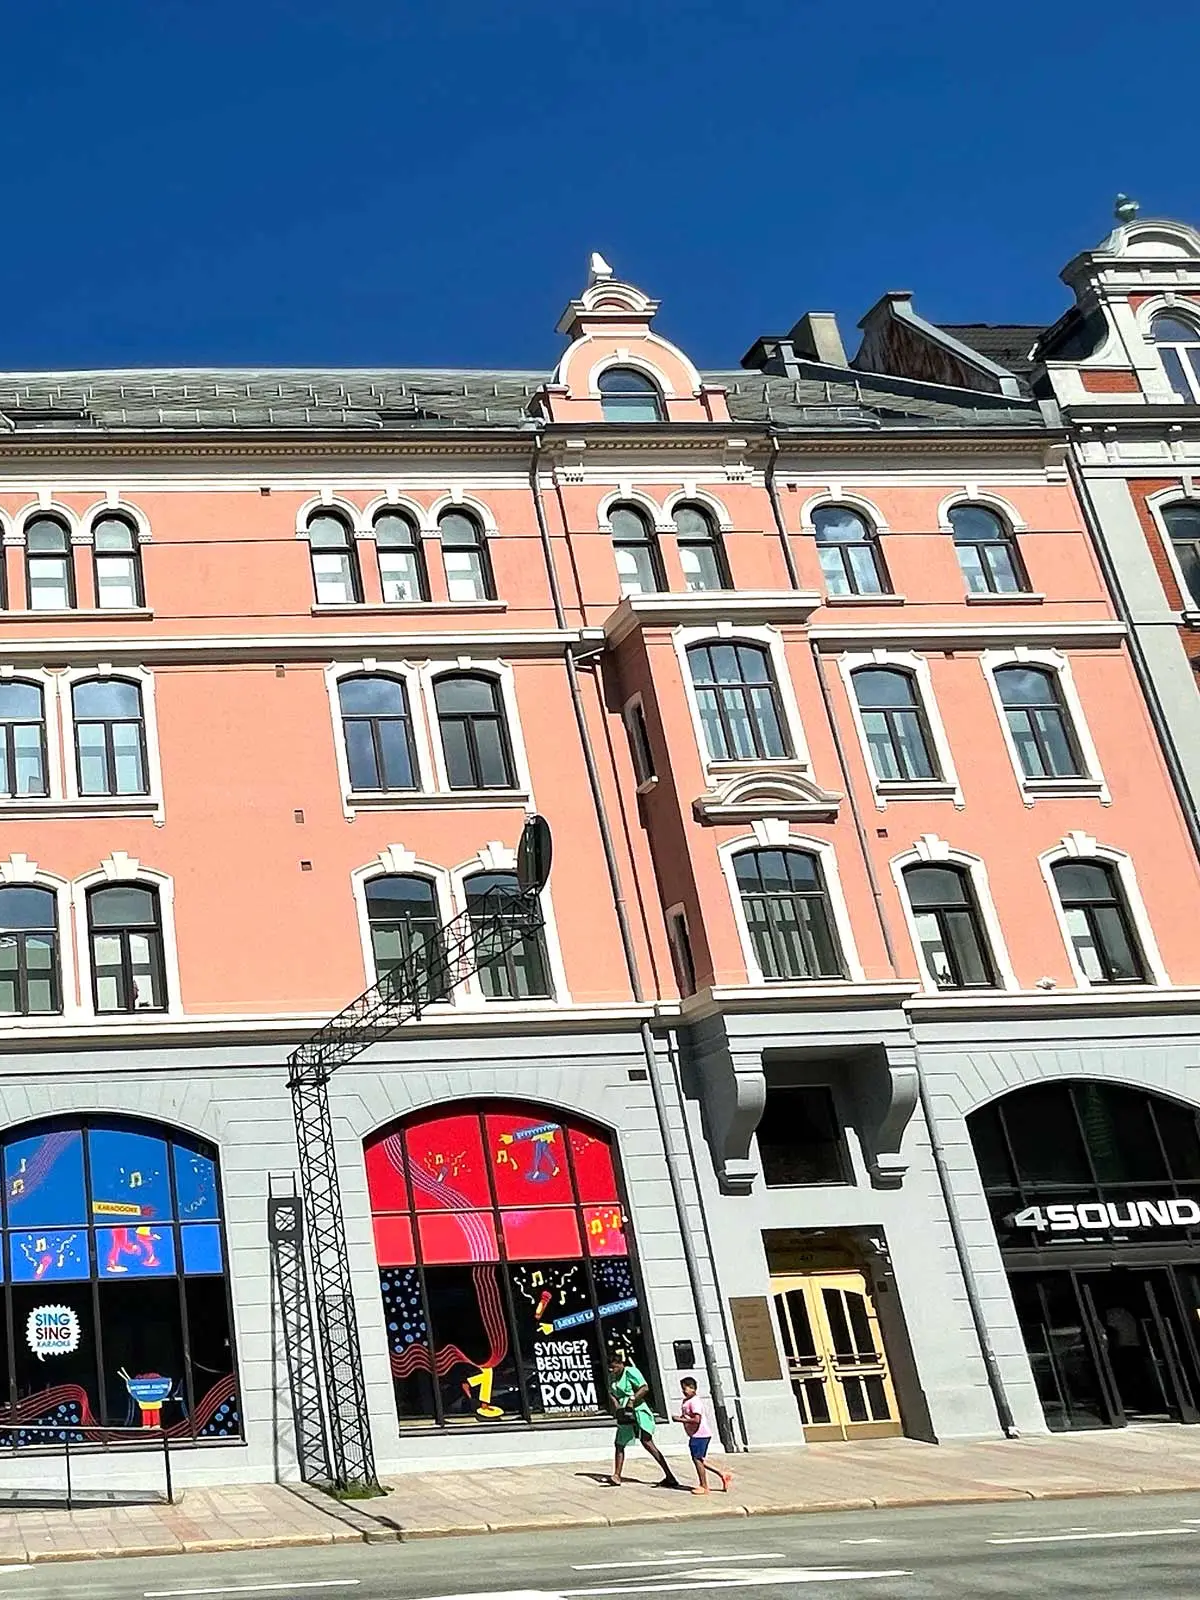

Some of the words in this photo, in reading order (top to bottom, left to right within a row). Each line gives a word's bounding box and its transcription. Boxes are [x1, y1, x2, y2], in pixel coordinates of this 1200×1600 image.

[1015, 1199, 1200, 1231] 4SOUND
[35, 1313, 70, 1326] SING
[36, 1327, 71, 1340] SING
[534, 1340, 588, 1355] SYNGE?
[536, 1355, 592, 1371] BESTILLE
[539, 1370, 594, 1383] KARAOKE
[541, 1383, 598, 1406] ROM
